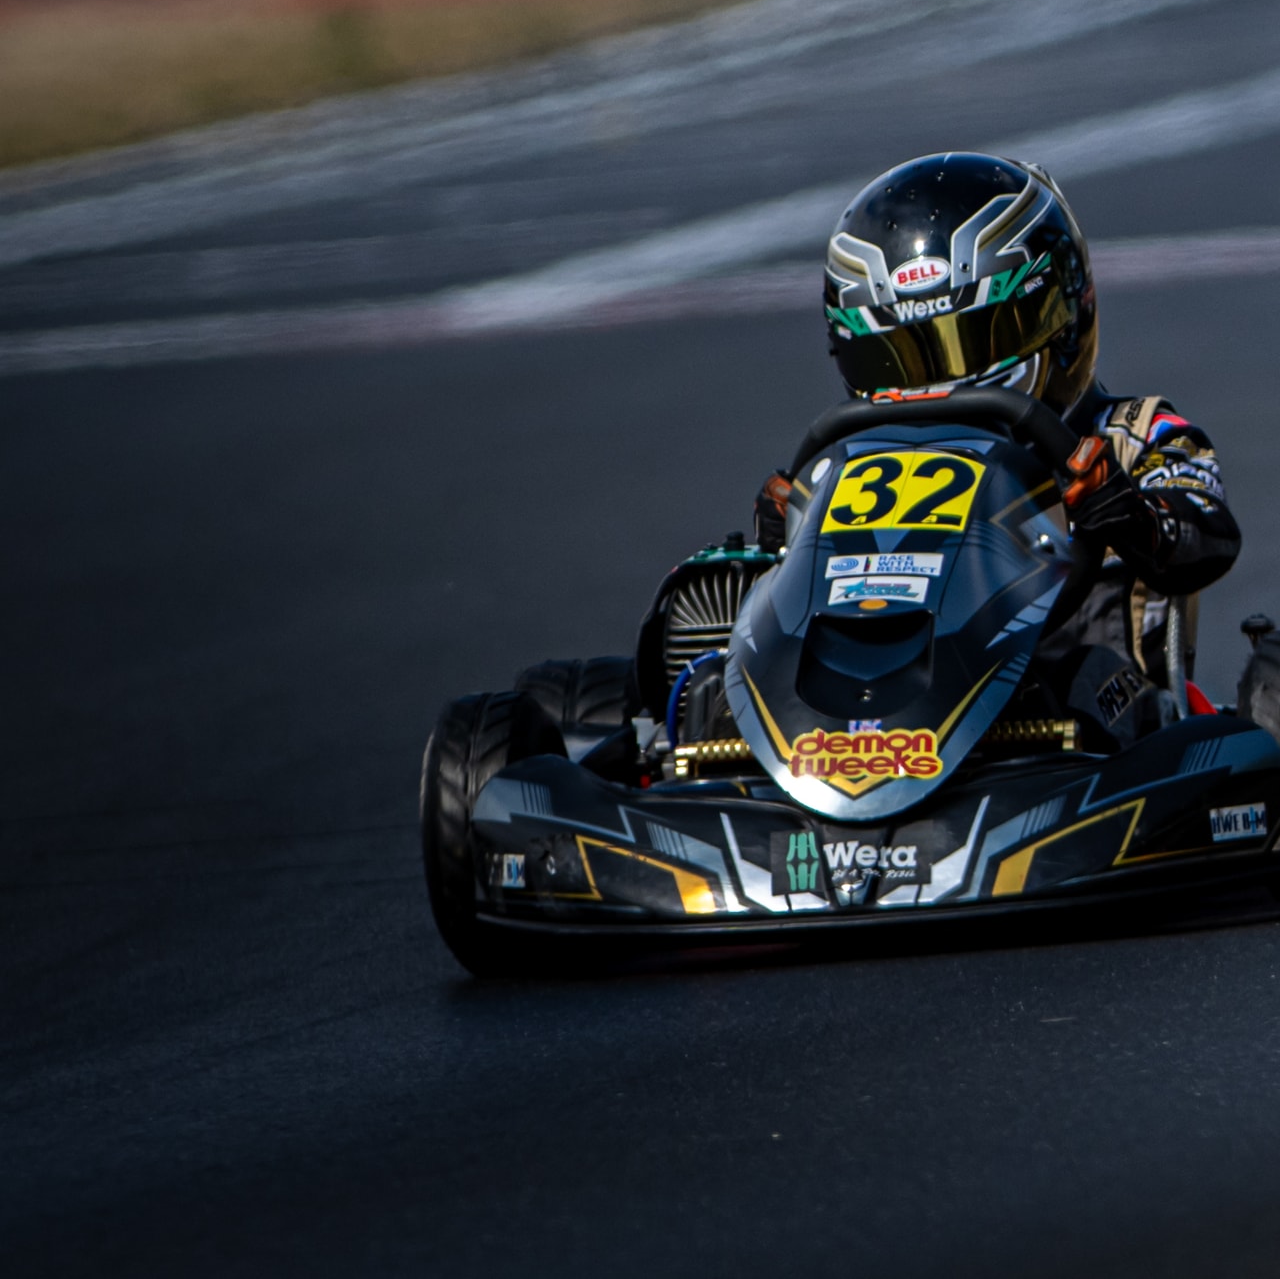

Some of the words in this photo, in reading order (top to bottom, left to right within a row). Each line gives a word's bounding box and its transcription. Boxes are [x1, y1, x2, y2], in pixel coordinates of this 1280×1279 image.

[897, 264, 940, 284] BELL
[894, 295, 953, 323] Wera
[830, 456, 976, 526] 32
[795, 728, 934, 756] demon
[789, 753, 940, 777] tweeks
[823, 841, 918, 870] Wera
